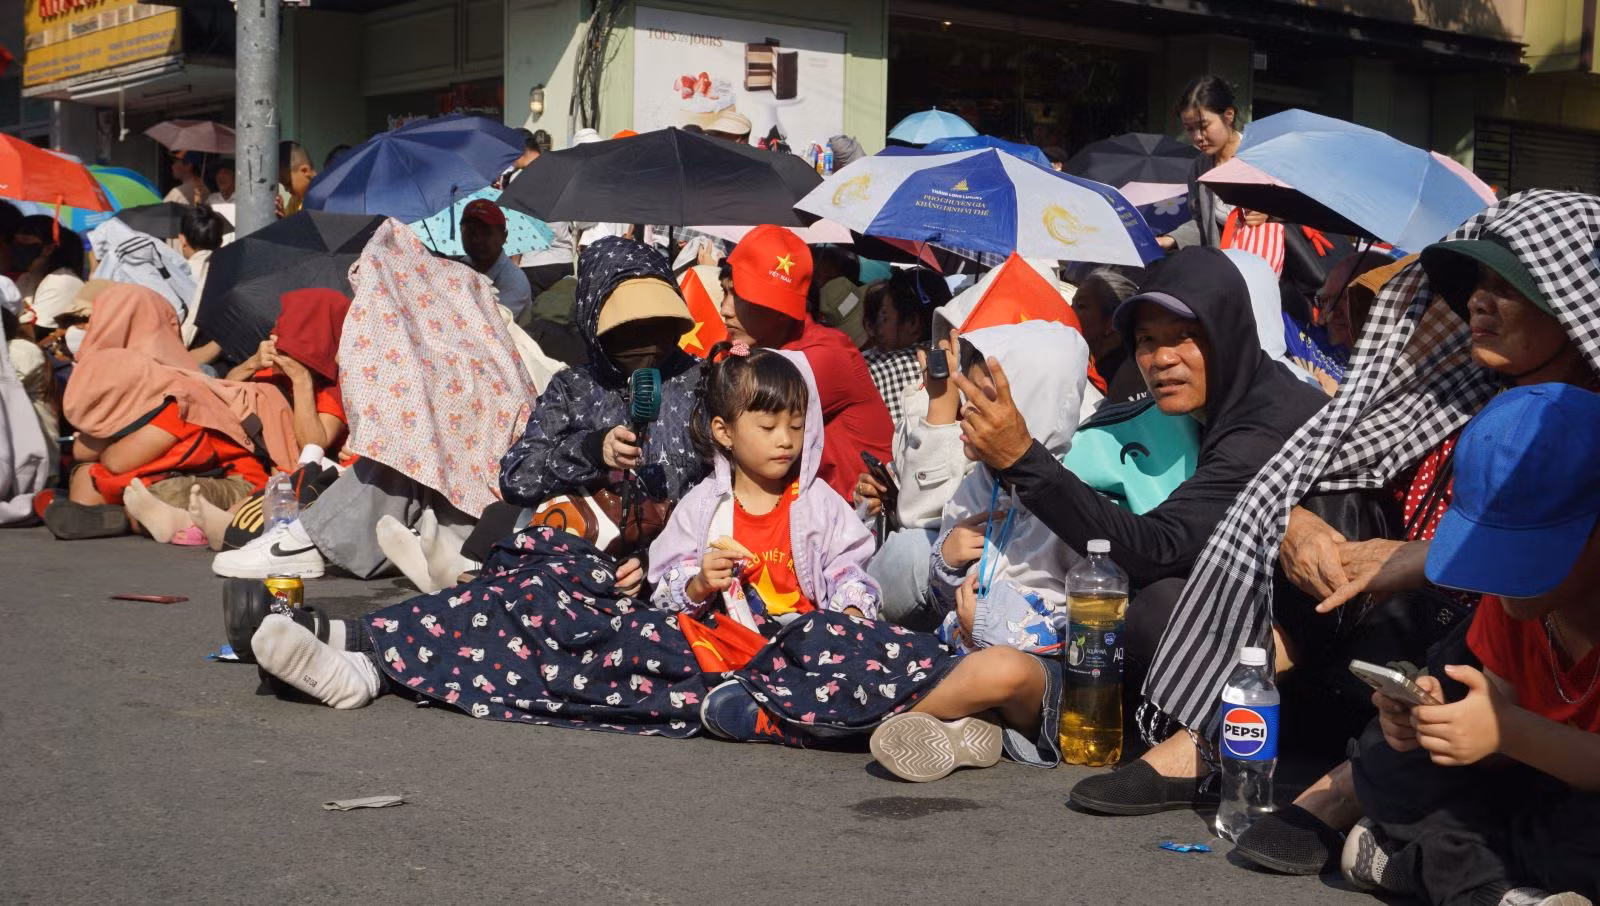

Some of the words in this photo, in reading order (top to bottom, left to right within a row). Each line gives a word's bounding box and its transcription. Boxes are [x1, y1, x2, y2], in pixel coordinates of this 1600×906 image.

[647, 28, 677, 42] TOUS
[690, 33, 723, 47] JOURS
[780, 273, 793, 284] NAM
[762, 547, 785, 565] VIỆT
[1224, 723, 1265, 738] PEPSI
